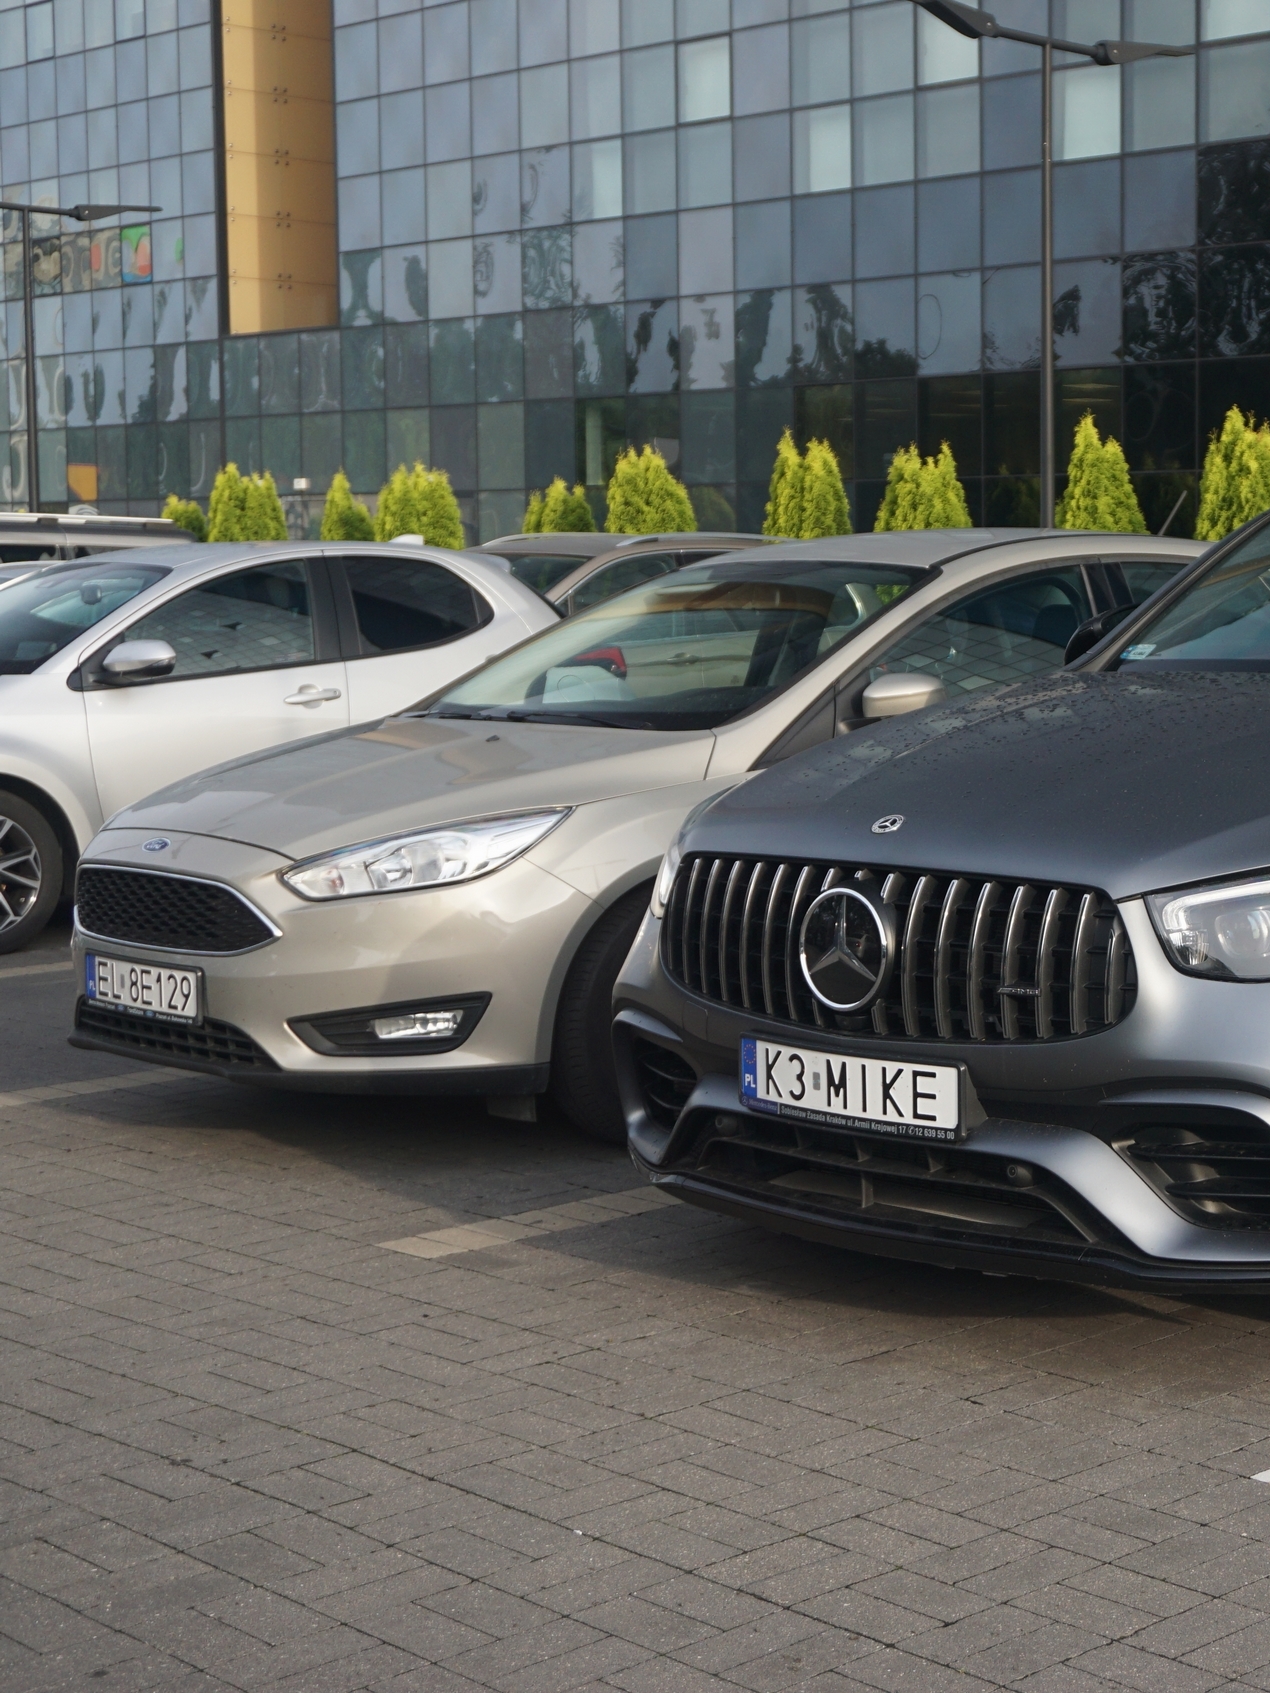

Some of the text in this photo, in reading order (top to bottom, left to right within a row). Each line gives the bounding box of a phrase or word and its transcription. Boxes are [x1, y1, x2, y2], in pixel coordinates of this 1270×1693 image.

[89, 980, 96, 990] PL
[97, 960, 193, 1012] EL 8E129
[744, 1073, 756, 1088] PL
[765, 1047, 937, 1122] K3 MIKE
[748, 1098, 777, 1111] Mercedes-Benz
[826, 1115, 847, 1126] Kraków
[871, 1122, 897, 1134] Krajowej
[898, 1126, 906, 1134] 17
[924, 1129, 936, 1138] 639
[937, 1130, 946, 1139] 55
[946, 1131, 955, 1140] 00
